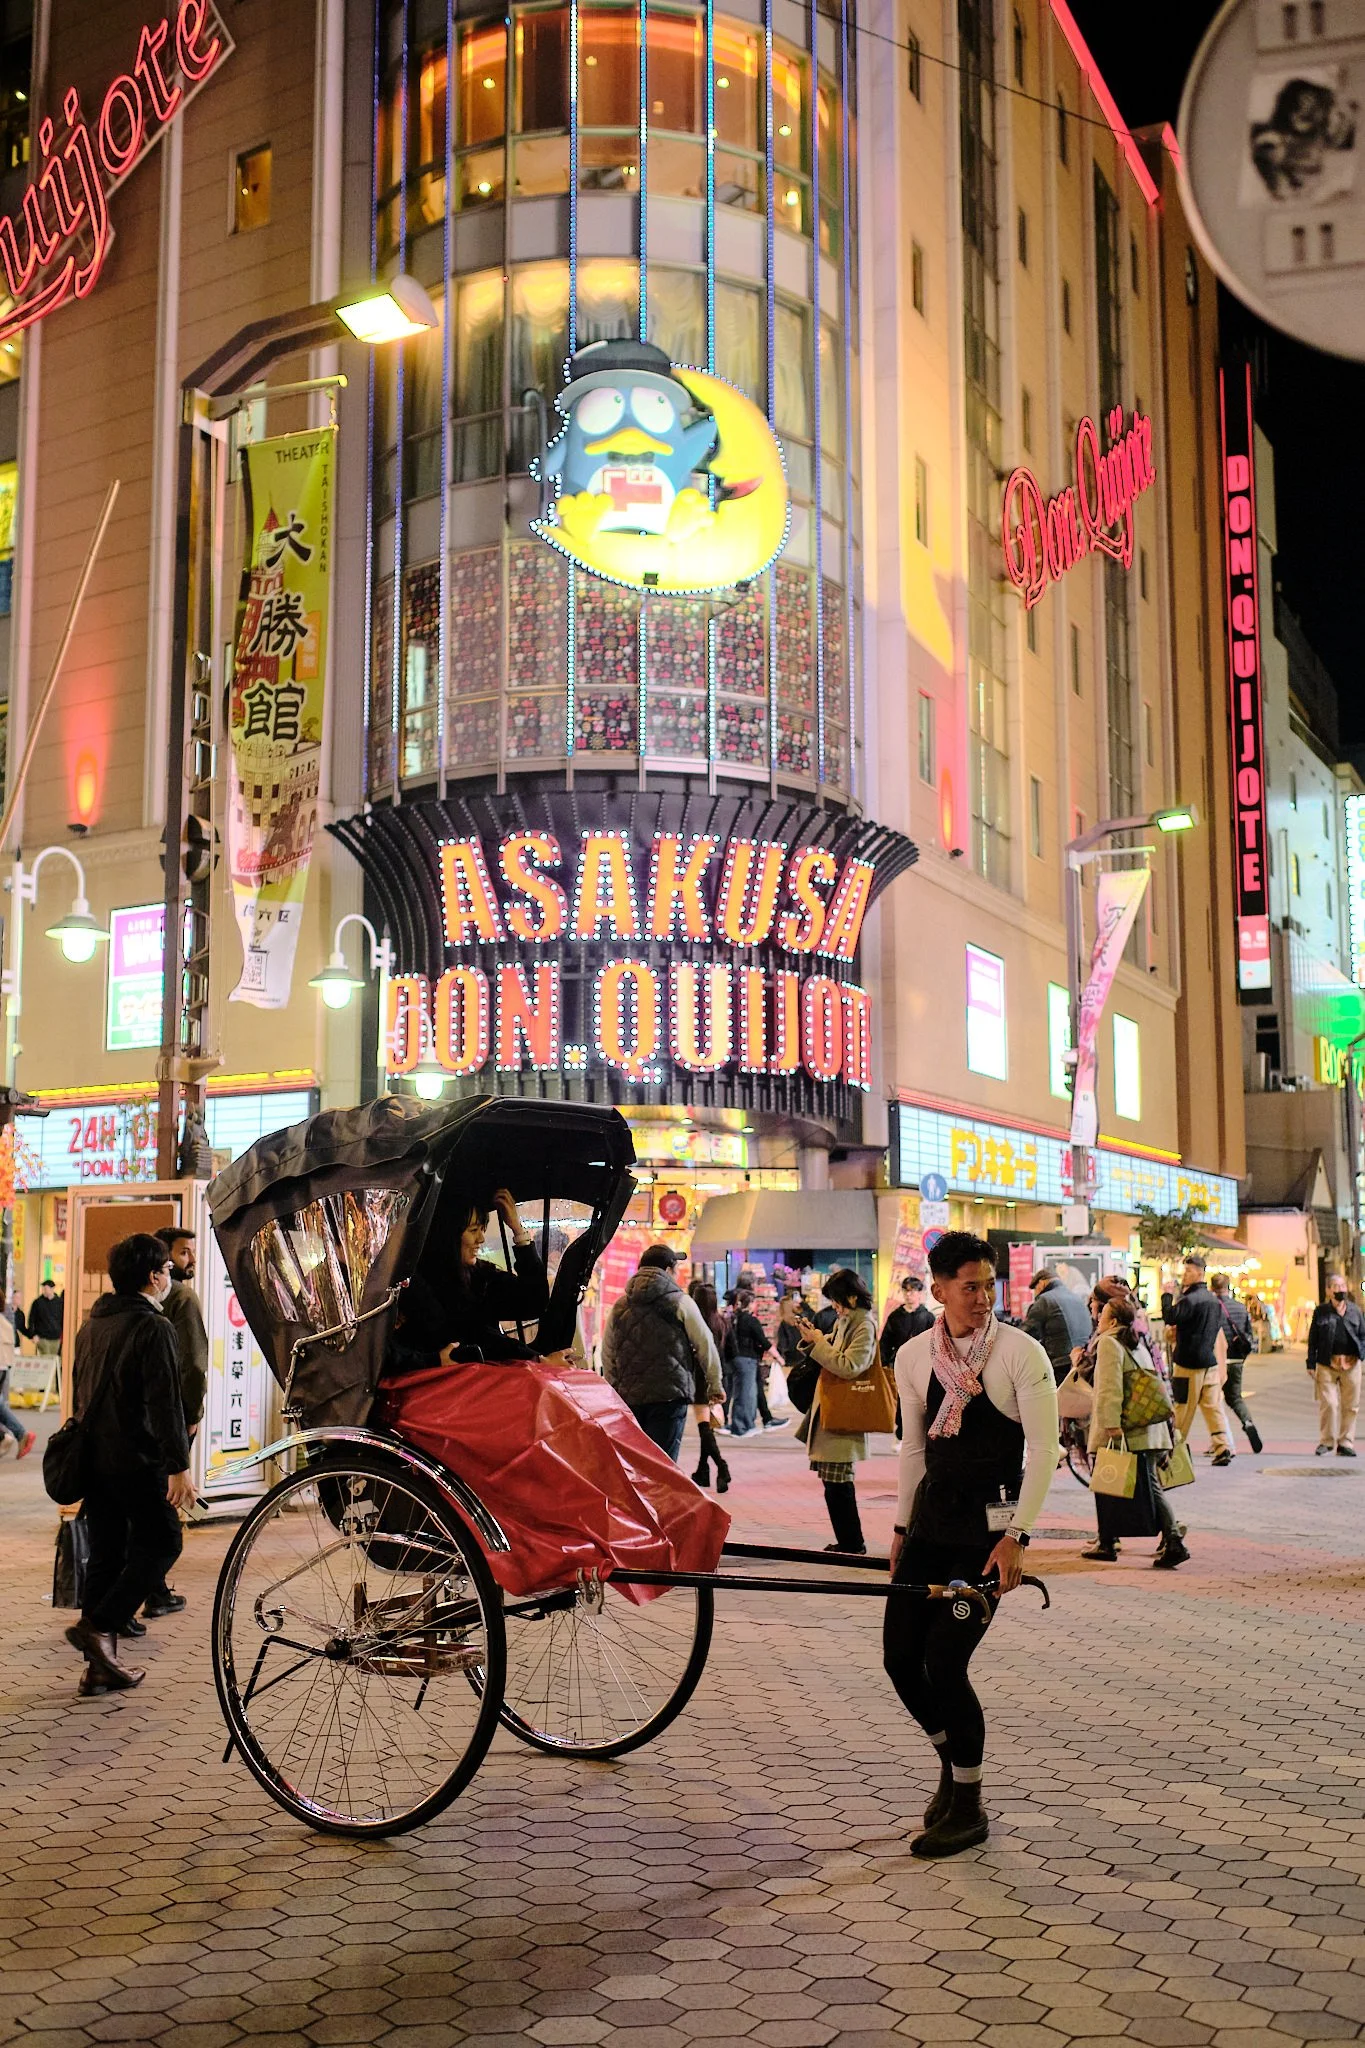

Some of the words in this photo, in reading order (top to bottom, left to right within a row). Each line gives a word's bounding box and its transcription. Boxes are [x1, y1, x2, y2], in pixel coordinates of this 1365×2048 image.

[0, 0, 221, 342] uijote
[275, 440, 329, 464] THEATER
[319, 464, 329, 573] TAISHOKAN
[1003, 466, 1086, 611] Don
[243, 512, 313, 743] 大勝館
[437, 829, 876, 964] ASAKUSA
